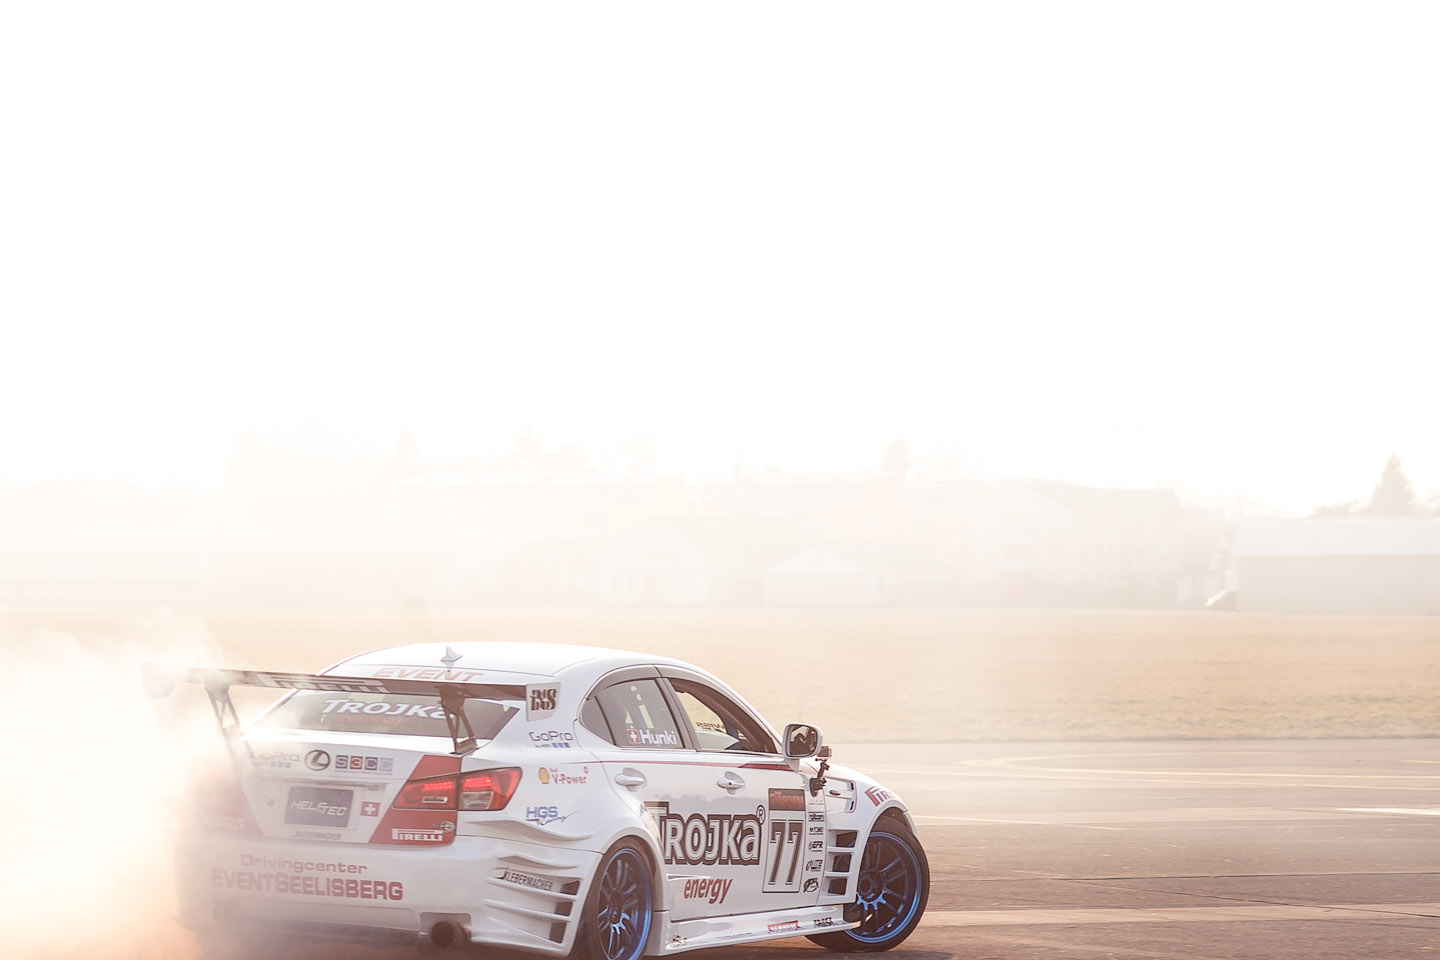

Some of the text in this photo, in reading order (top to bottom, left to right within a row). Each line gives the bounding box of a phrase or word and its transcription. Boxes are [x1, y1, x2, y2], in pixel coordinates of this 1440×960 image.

[371, 666, 485, 684] EVENT
[528, 730, 574, 742] GoPro
[639, 729, 678, 745] Hunki
[551, 773, 587, 785] V-Power
[525, 806, 559, 819] HGS
[392, 828, 443, 842] PIRELLI
[767, 818, 804, 886] 77
[240, 854, 368, 874] Drivingcenter
[211, 866, 404, 901] EVENTSEELISBERG
[683, 878, 733, 904] energy
